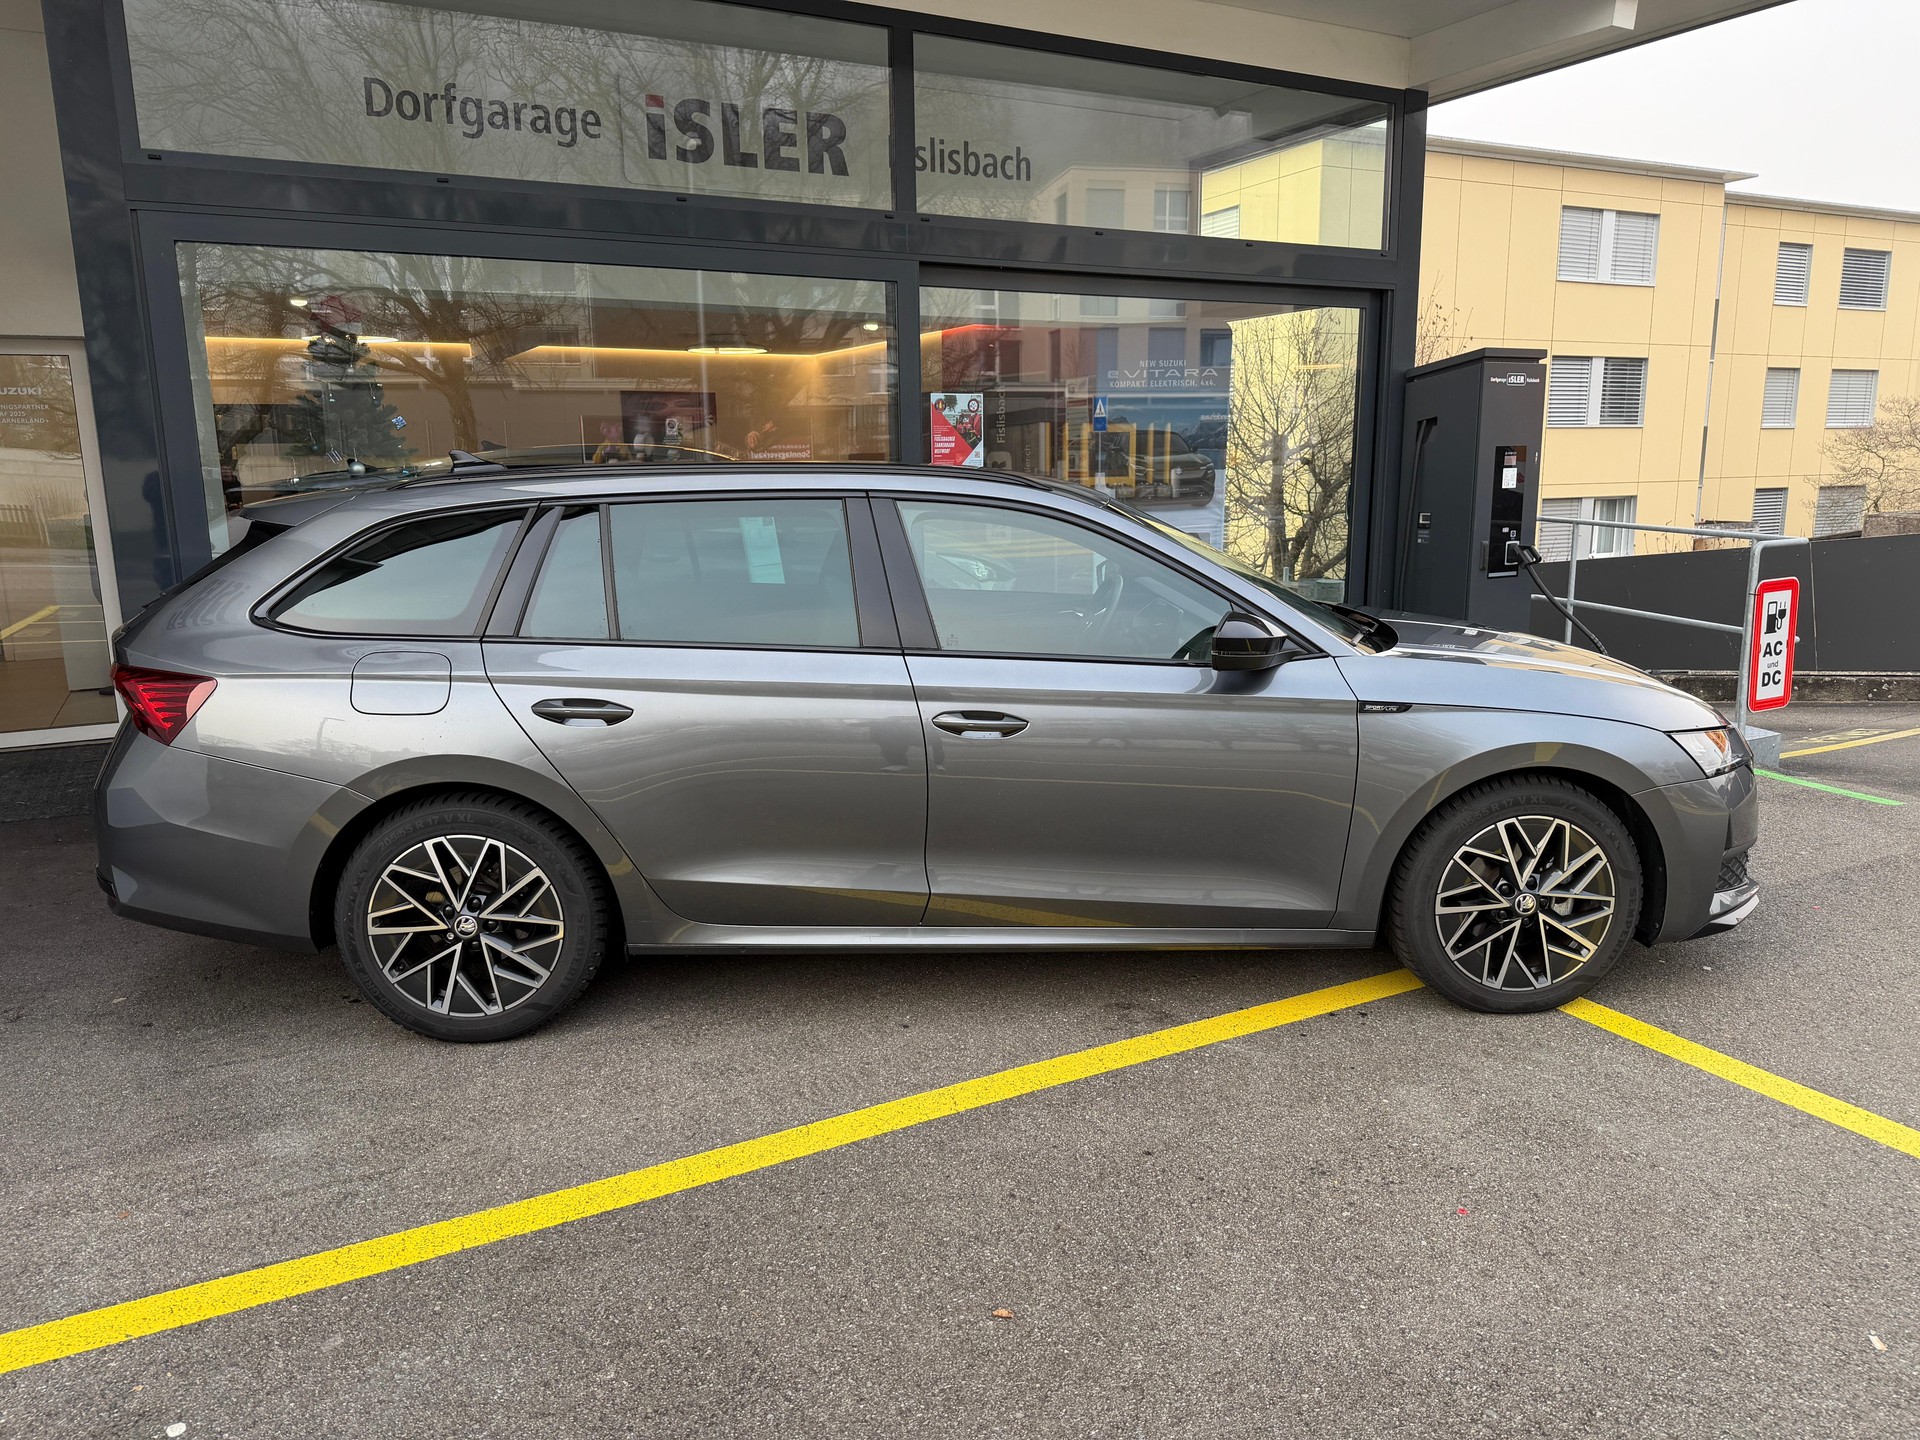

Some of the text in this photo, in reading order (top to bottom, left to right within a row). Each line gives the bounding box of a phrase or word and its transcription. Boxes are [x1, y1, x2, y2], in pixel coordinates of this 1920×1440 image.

[363, 77, 1032, 182] Dorfgarage iSLER slisbach
[1124, 368, 1218, 378] VITARA
[1109, 380, 1148, 388] KOMPAKT.
[1150, 379, 1198, 387] ELEKTRISCH.
[1762, 640, 1783, 658] AC
[1766, 660, 1779, 669] und
[1761, 669, 1782, 688] DC
[1454, 794, 1545, 834] 205/55 R 17 V XL
[377, 813, 474, 851] 205/55 R 17 V XL
